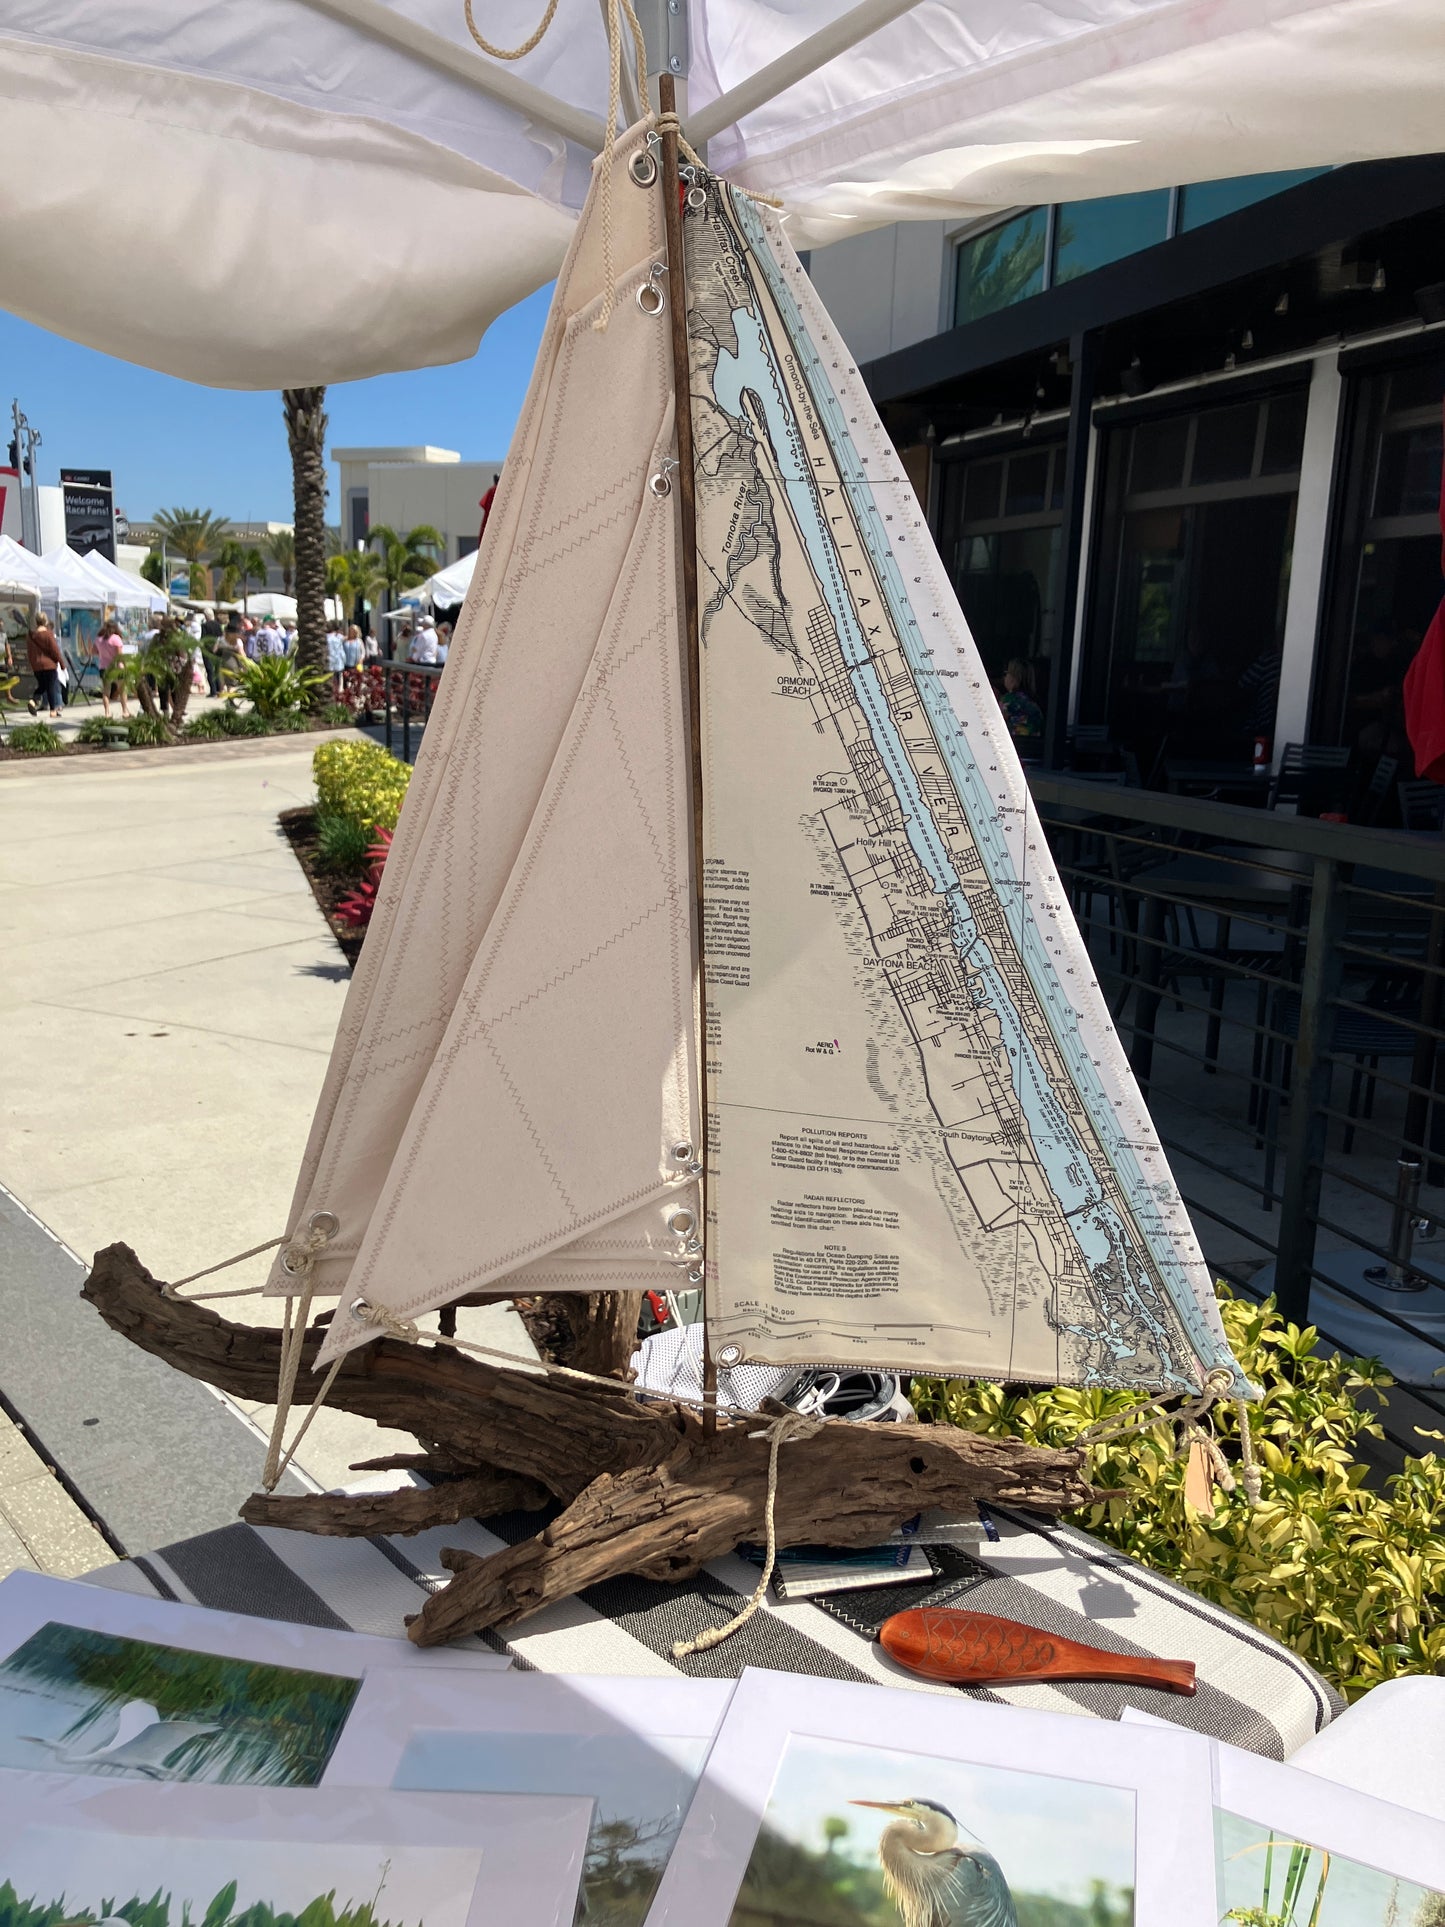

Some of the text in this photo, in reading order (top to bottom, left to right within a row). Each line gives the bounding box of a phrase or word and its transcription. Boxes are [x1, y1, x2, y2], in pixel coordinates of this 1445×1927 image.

[725, 255, 743, 288] Creek
[784, 354, 820, 441] Ormond-by-the-Sea
[65, 496, 105, 506] Welcome
[66, 505, 86, 515] Race
[721, 481, 749, 555] Tomoka River
[913, 667, 959, 678] Ellinor Village
[777, 676, 816, 687] ORMOND
[781, 685, 812, 695] BEACH
[856, 837, 877, 848] Holly
[994, 877, 1031, 888] Seabreeze
[862, 957, 938, 972] DAYTONA BEACH
[816, 1041, 834, 1049] AERO
[802, 1127, 868, 1140] POLLUTION REPORTS
[937, 1129, 993, 1142] South Daytona
[1035, 1200, 1051, 1209] Port
[1029, 1207, 1056, 1216] Orange
[1145, 1229, 1168, 1238] Halifax
[1052, 1275, 1084, 1286] Allandale
[734, 1300, 760, 1309] SCALE
[1168, 1325, 1186, 1359] Halifax
